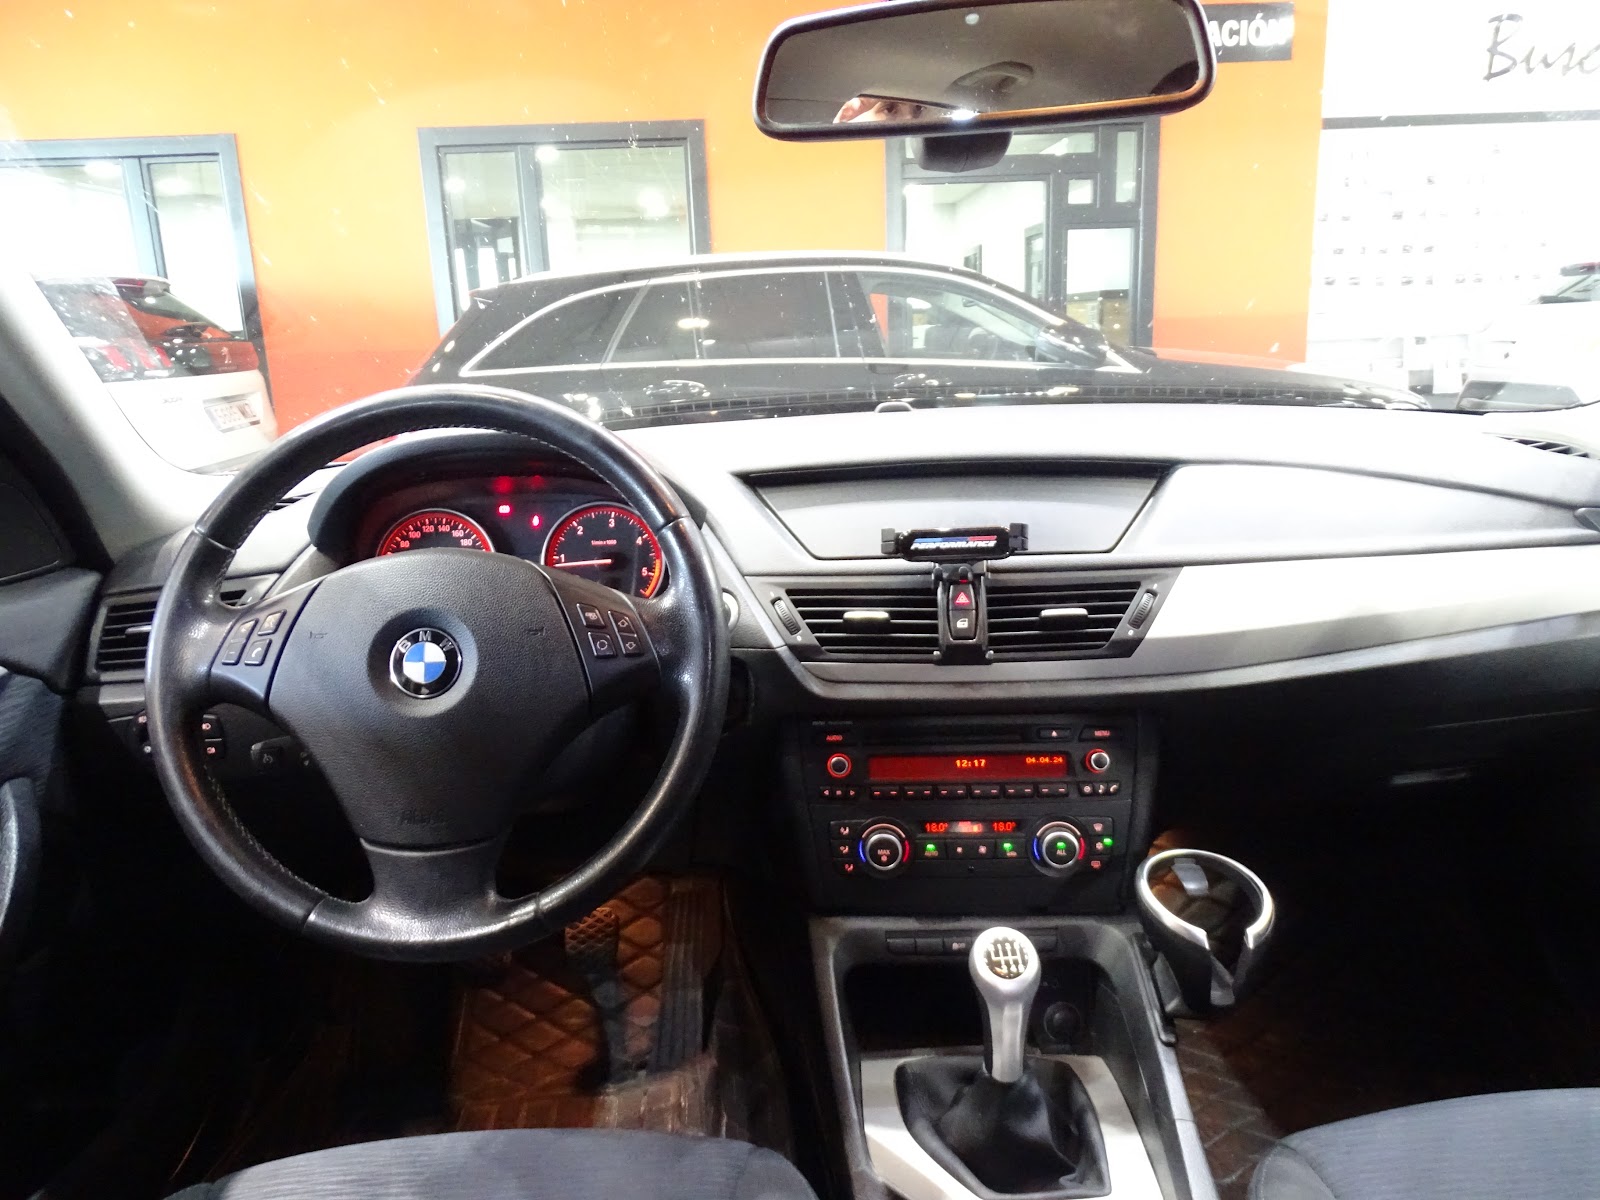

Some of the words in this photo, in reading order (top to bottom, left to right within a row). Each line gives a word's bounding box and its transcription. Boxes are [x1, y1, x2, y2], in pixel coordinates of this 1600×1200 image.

[609, 519, 615, 528] 3
[422, 525, 434, 533] 120
[577, 526, 584, 535] 2
[460, 538, 472, 546] 180
[636, 536, 643, 545] 4
[910, 540, 997, 550] PERFORMANCE
[560, 554, 565, 562] 1
[641, 567, 648, 576] 5
[398, 630, 455, 654] BMW
[955, 759, 986, 768] 12:17
[1026, 756, 1063, 764] 04.04.24
